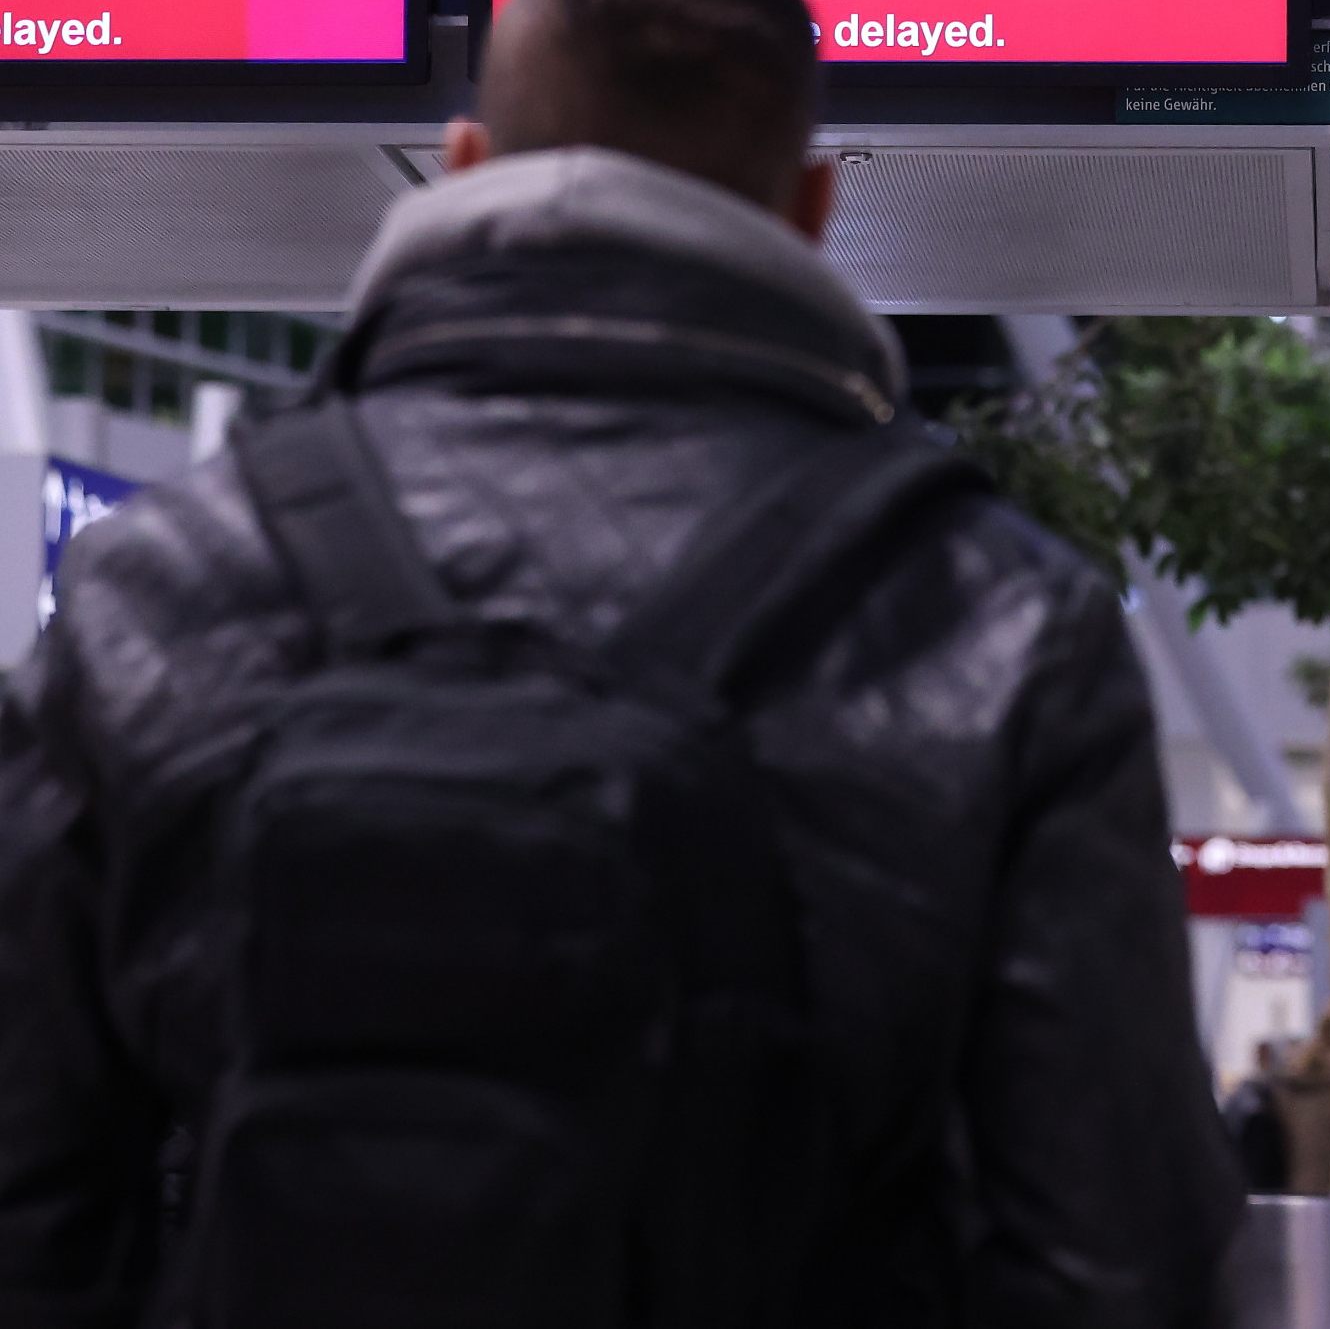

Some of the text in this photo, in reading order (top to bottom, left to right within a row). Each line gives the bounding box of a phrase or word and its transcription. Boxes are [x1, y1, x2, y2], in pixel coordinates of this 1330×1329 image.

[0, 12, 121, 54] layed.
[835, 14, 1004, 56] delayed.
[1126, 98, 1217, 111] keine Gewähr.
